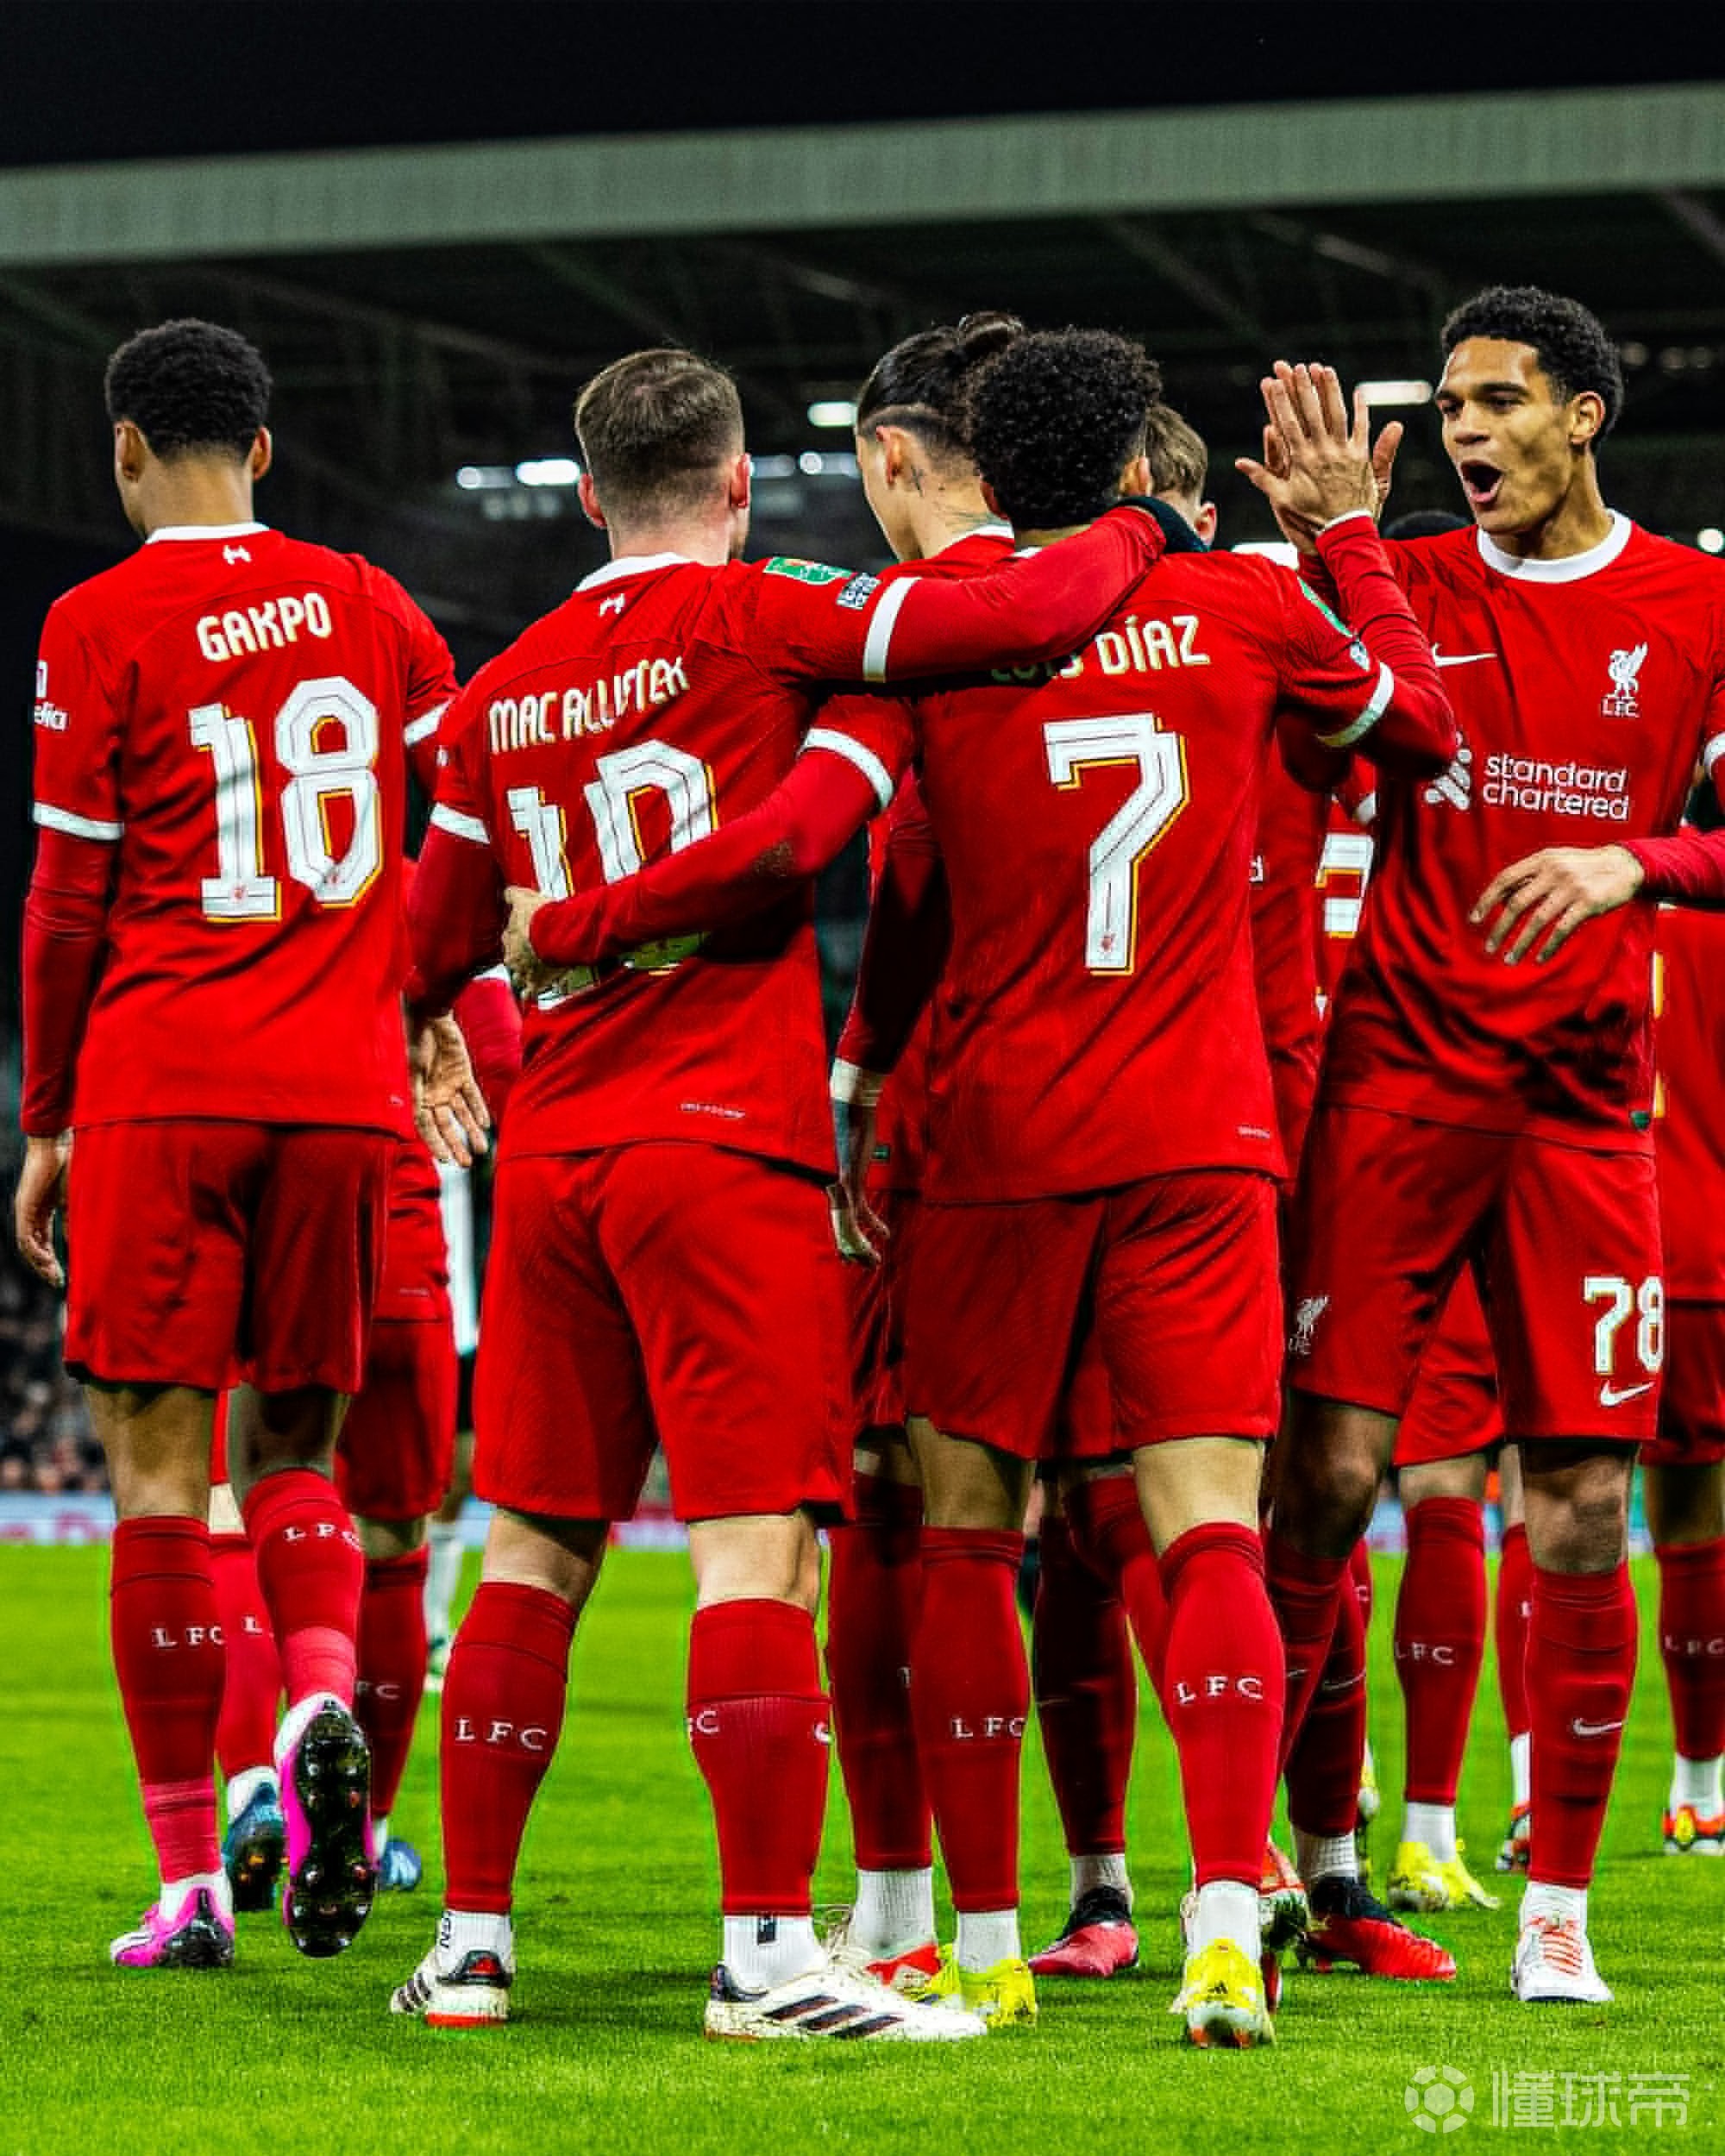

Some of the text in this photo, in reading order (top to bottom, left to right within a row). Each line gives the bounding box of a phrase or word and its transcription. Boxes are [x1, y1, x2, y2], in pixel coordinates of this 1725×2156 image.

[197, 593, 332, 662] GAKPO
[1095, 614, 1211, 675] DÍAZ
[489, 692, 557, 747] MAC
[188, 676, 382, 923] 18
[1483, 779, 1630, 820] chartered
[1484, 753, 1628, 793] standard
[1043, 711, 1189, 976] 7
[1584, 1275, 1663, 1375] 78
[1175, 1676, 1264, 1705] LFC
[455, 1717, 549, 1752] LFC
